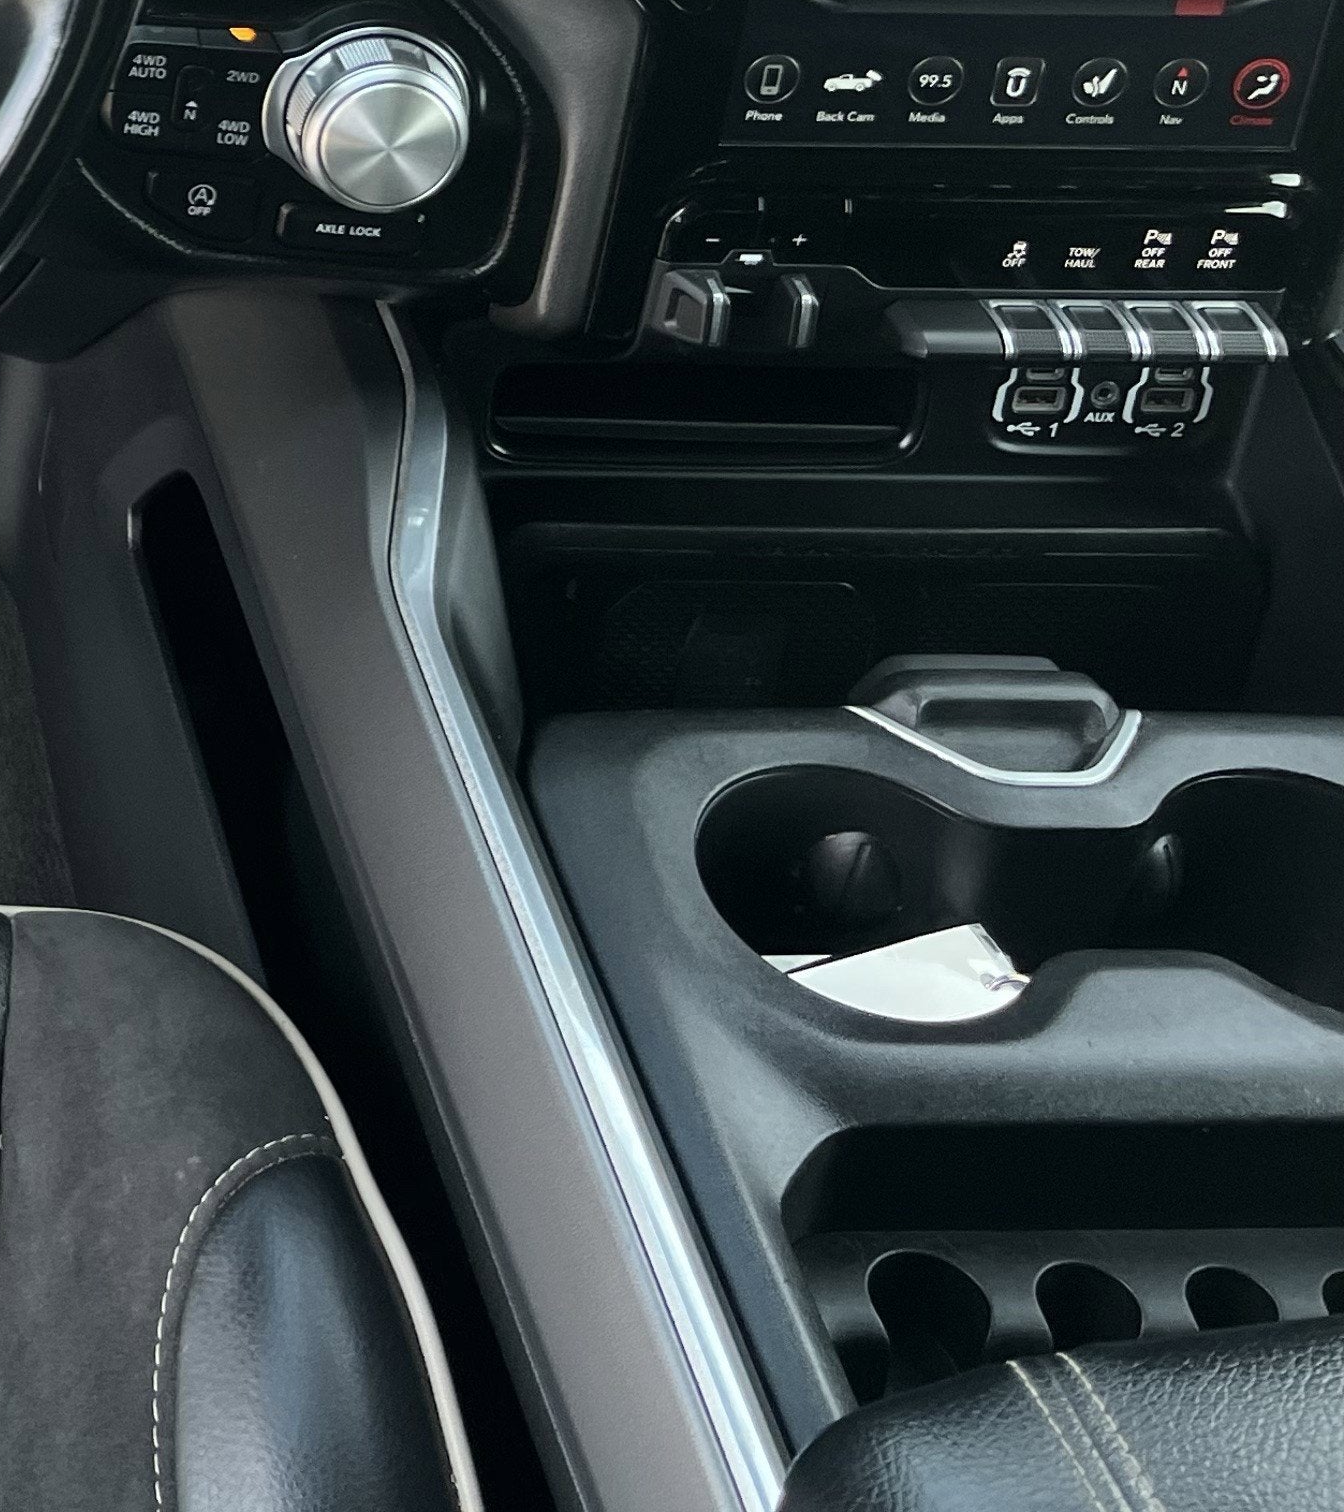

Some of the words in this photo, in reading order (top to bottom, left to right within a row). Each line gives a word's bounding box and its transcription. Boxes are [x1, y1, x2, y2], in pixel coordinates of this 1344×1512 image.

[132, 54, 168, 68] 4WD
[128, 65, 167, 80] AUTO
[225, 70, 260, 84] 2WD
[918, 74, 953, 89] 99.5
[1170, 79, 1189, 97] N
[127, 110, 161, 125] 4WD
[182, 107, 198, 122] N
[744, 110, 784, 123] Phone
[815, 110, 844, 123] Back
[846, 111, 876, 123] Cam
[907, 112, 947, 124] Media
[1065, 112, 1115, 126] Controls
[1158, 114, 1184, 126] Nav
[123, 122, 160, 138] HIGH
[217, 119, 251, 134] 4WD
[215, 131, 249, 147] LOW
[187, 205, 212, 217] OFF
[315, 223, 346, 237] AXLE
[349, 225, 382, 239] LOCK
[1143, 229, 1159, 245] P
[1211, 229, 1226, 246] P
[1068, 247, 1101, 258] TOW/
[1141, 247, 1166, 258] OFF
[1208, 247, 1233, 258] OFF
[1002, 257, 1027, 269] OFF
[1063, 259, 1097, 269] HAUL
[1133, 259, 1166, 269] REAR
[1196, 259, 1237, 269] FRONT
[1083, 412, 1115, 423] AUX
[1049, 422, 1059, 438] 1
[1170, 422, 1186, 438] 2
